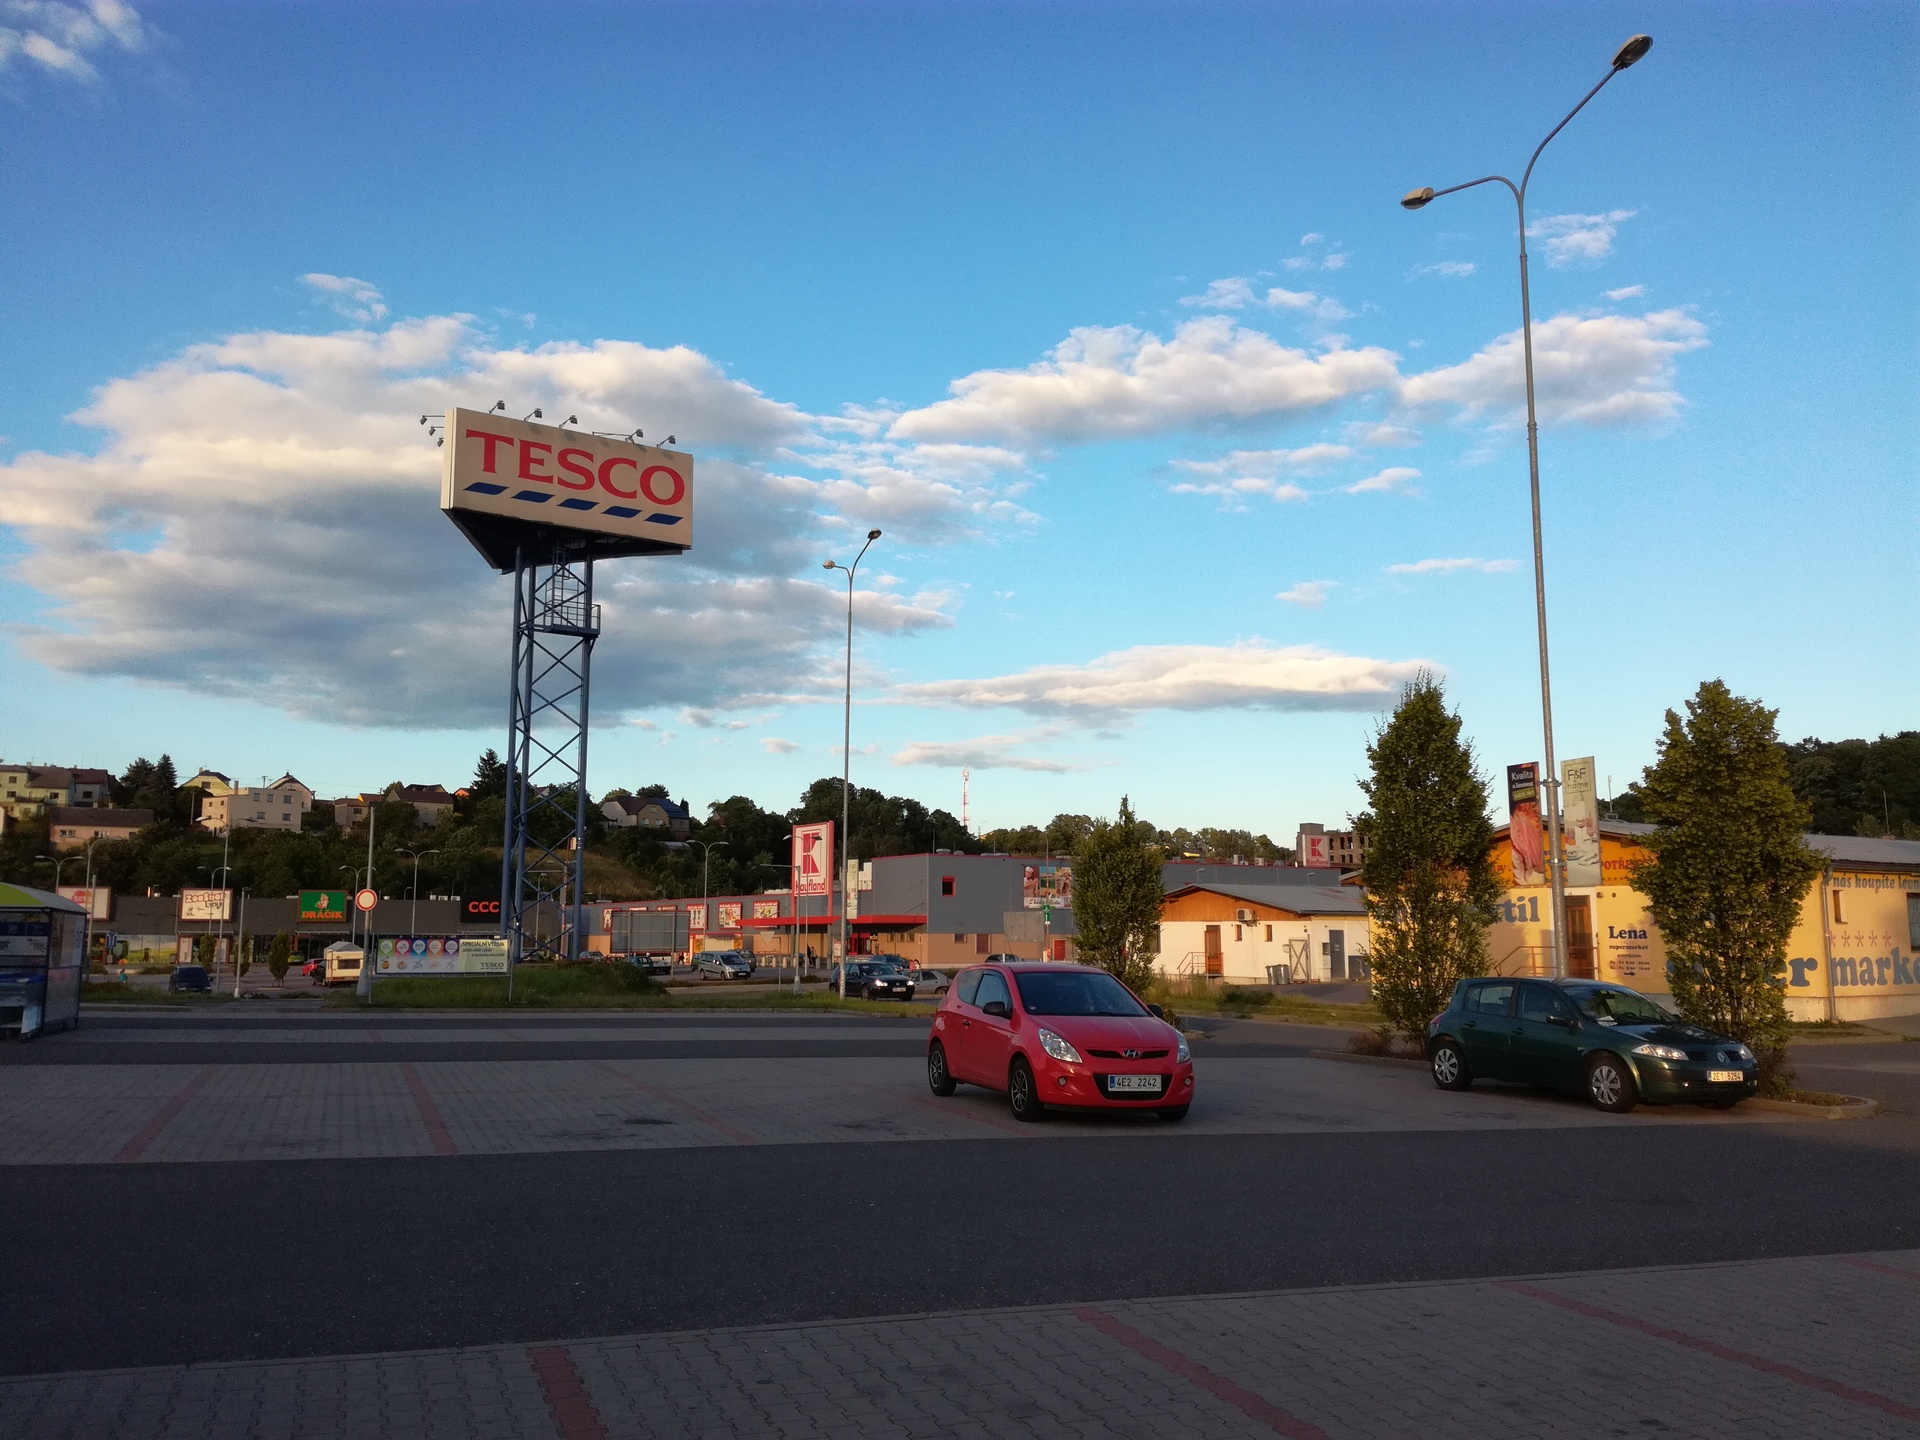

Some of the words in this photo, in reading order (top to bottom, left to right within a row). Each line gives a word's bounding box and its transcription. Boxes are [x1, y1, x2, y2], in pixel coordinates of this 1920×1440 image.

[466, 429, 686, 506] TESCO
[1511, 770, 1534, 781] Kvalita
[1567, 767, 1587, 781] F&F
[1567, 781, 1589, 790] home
[1832, 872, 1852, 888] nás
[468, 901, 500, 913] CCC
[301, 909, 343, 919] DRÁČIK
[1608, 925, 1648, 939] Lena
[1116, 1077, 1132, 1087] 4E2
[1137, 1077, 1157, 1087] 2242
